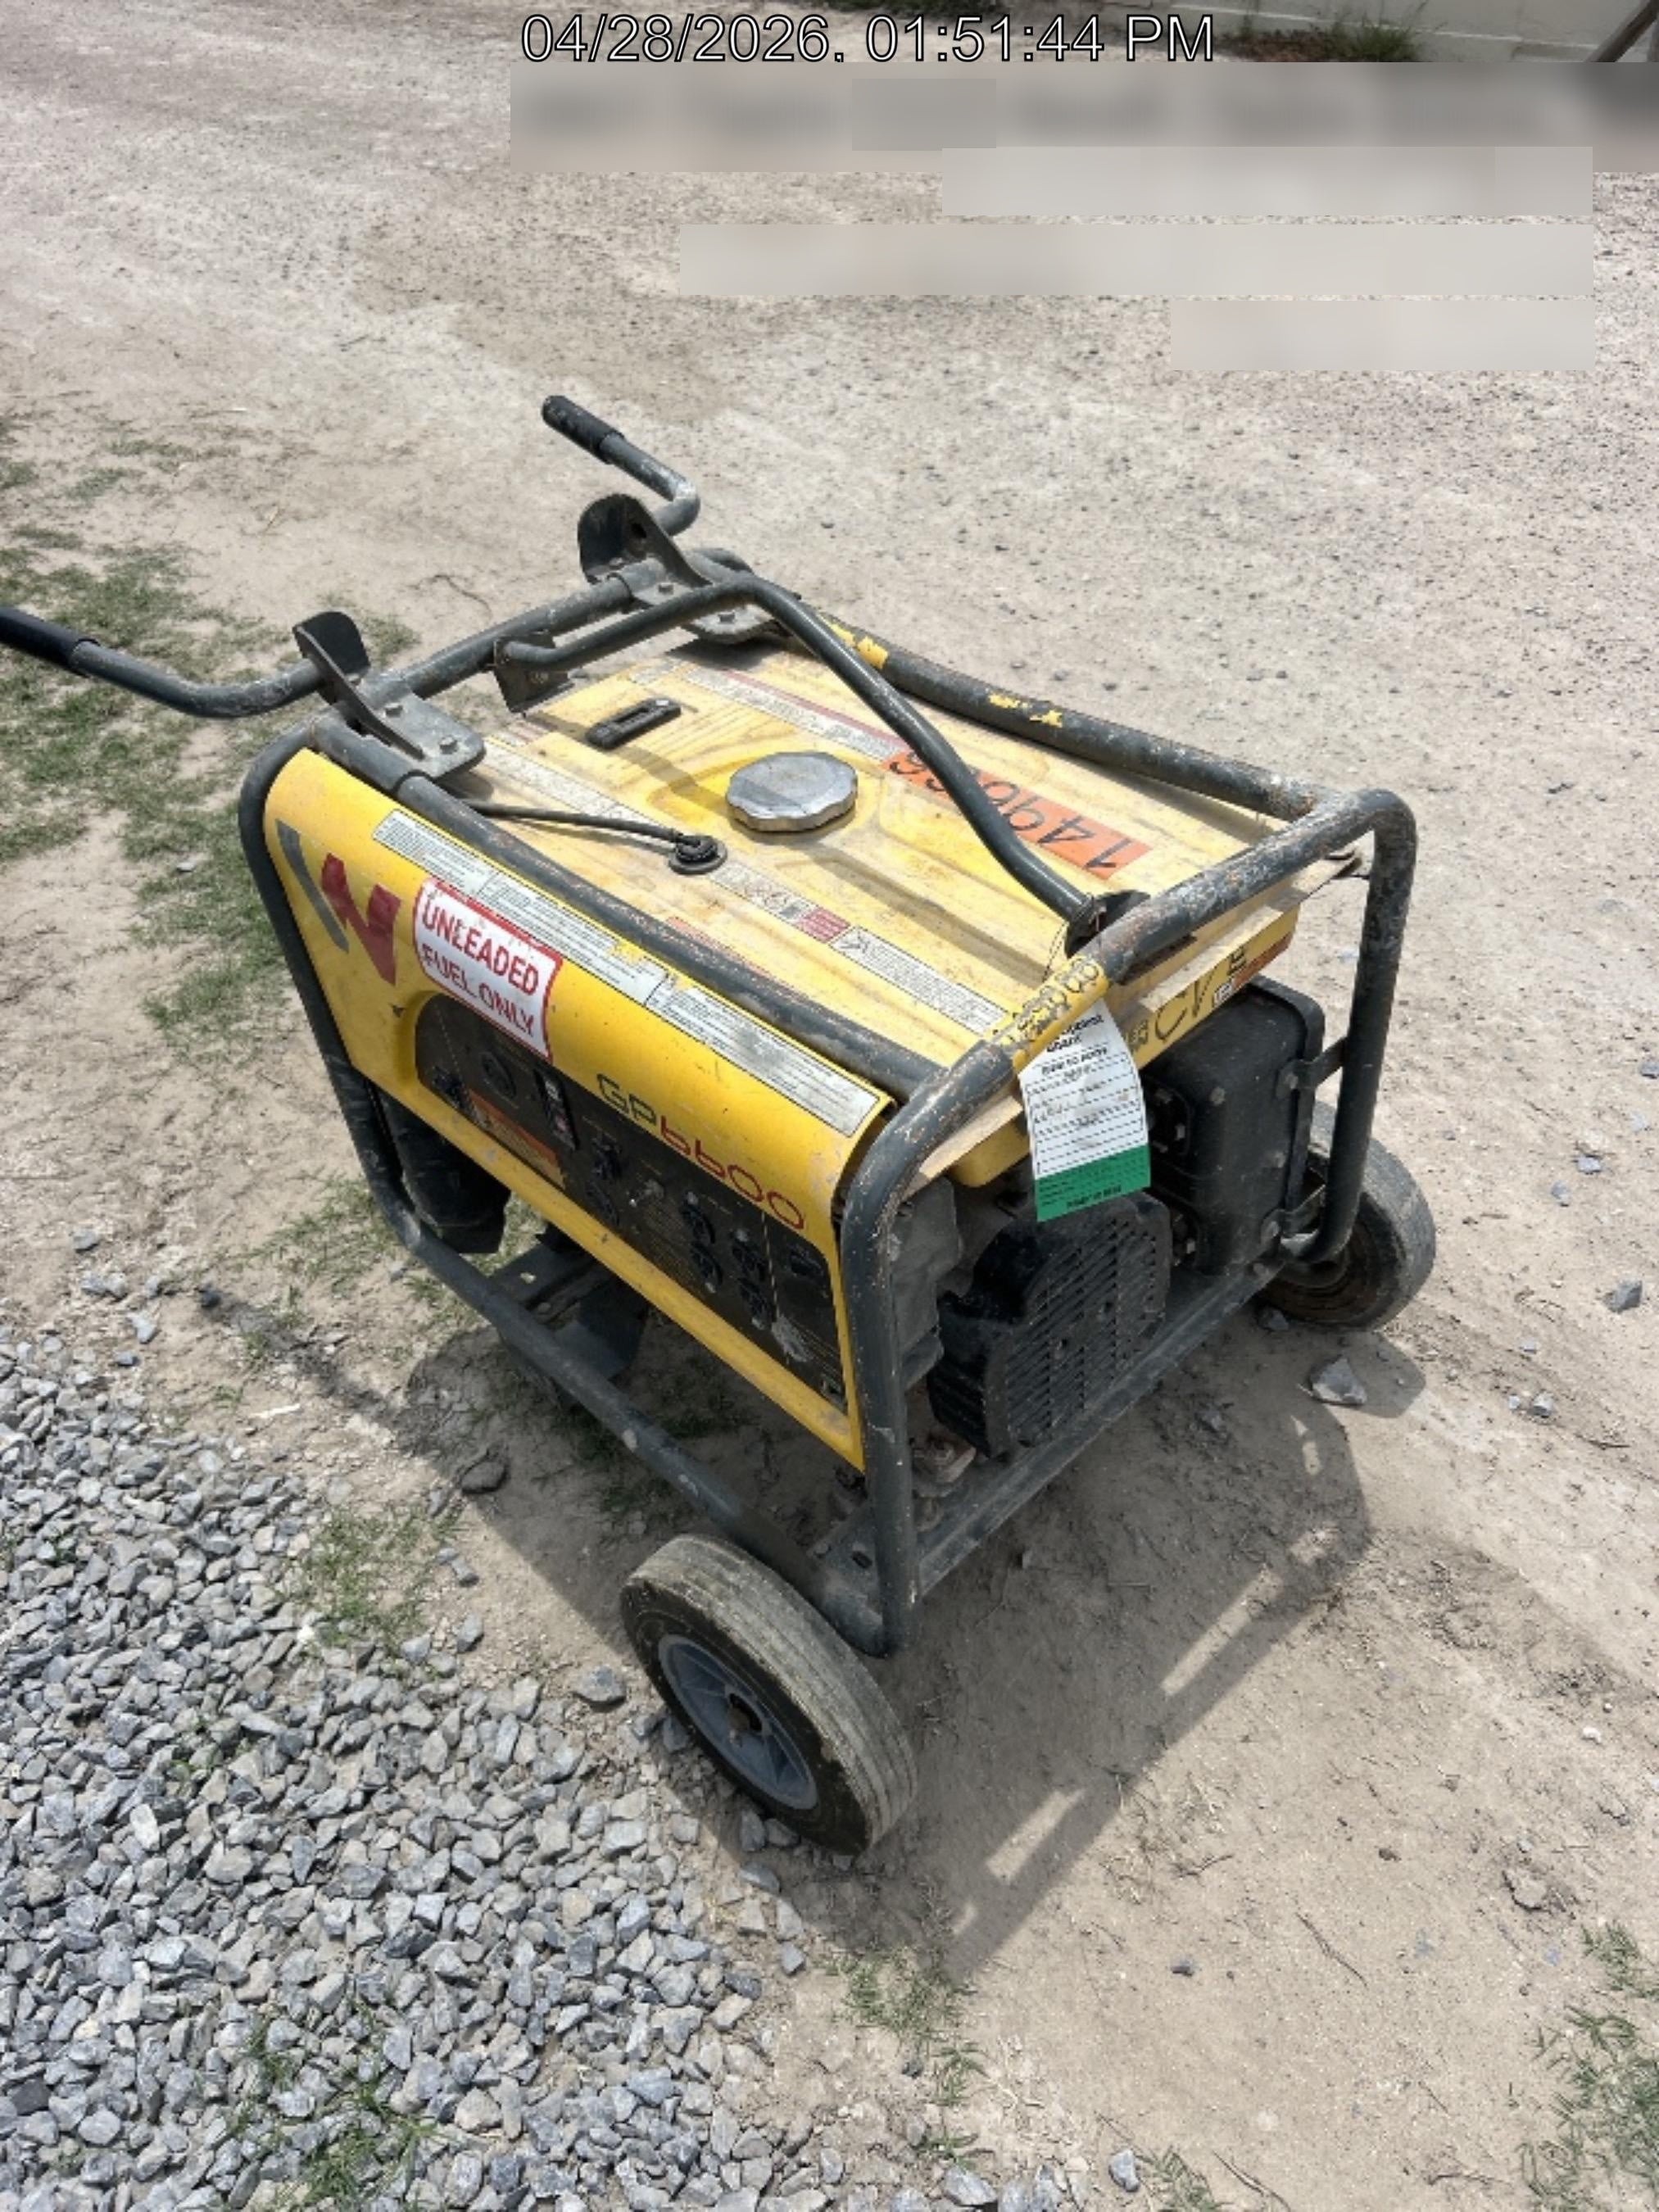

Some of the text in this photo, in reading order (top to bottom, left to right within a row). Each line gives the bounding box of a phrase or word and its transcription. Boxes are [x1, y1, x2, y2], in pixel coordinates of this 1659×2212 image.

[422, 899, 539, 996] UNLEADED
[422, 943, 534, 1038] FUEL ONLY
